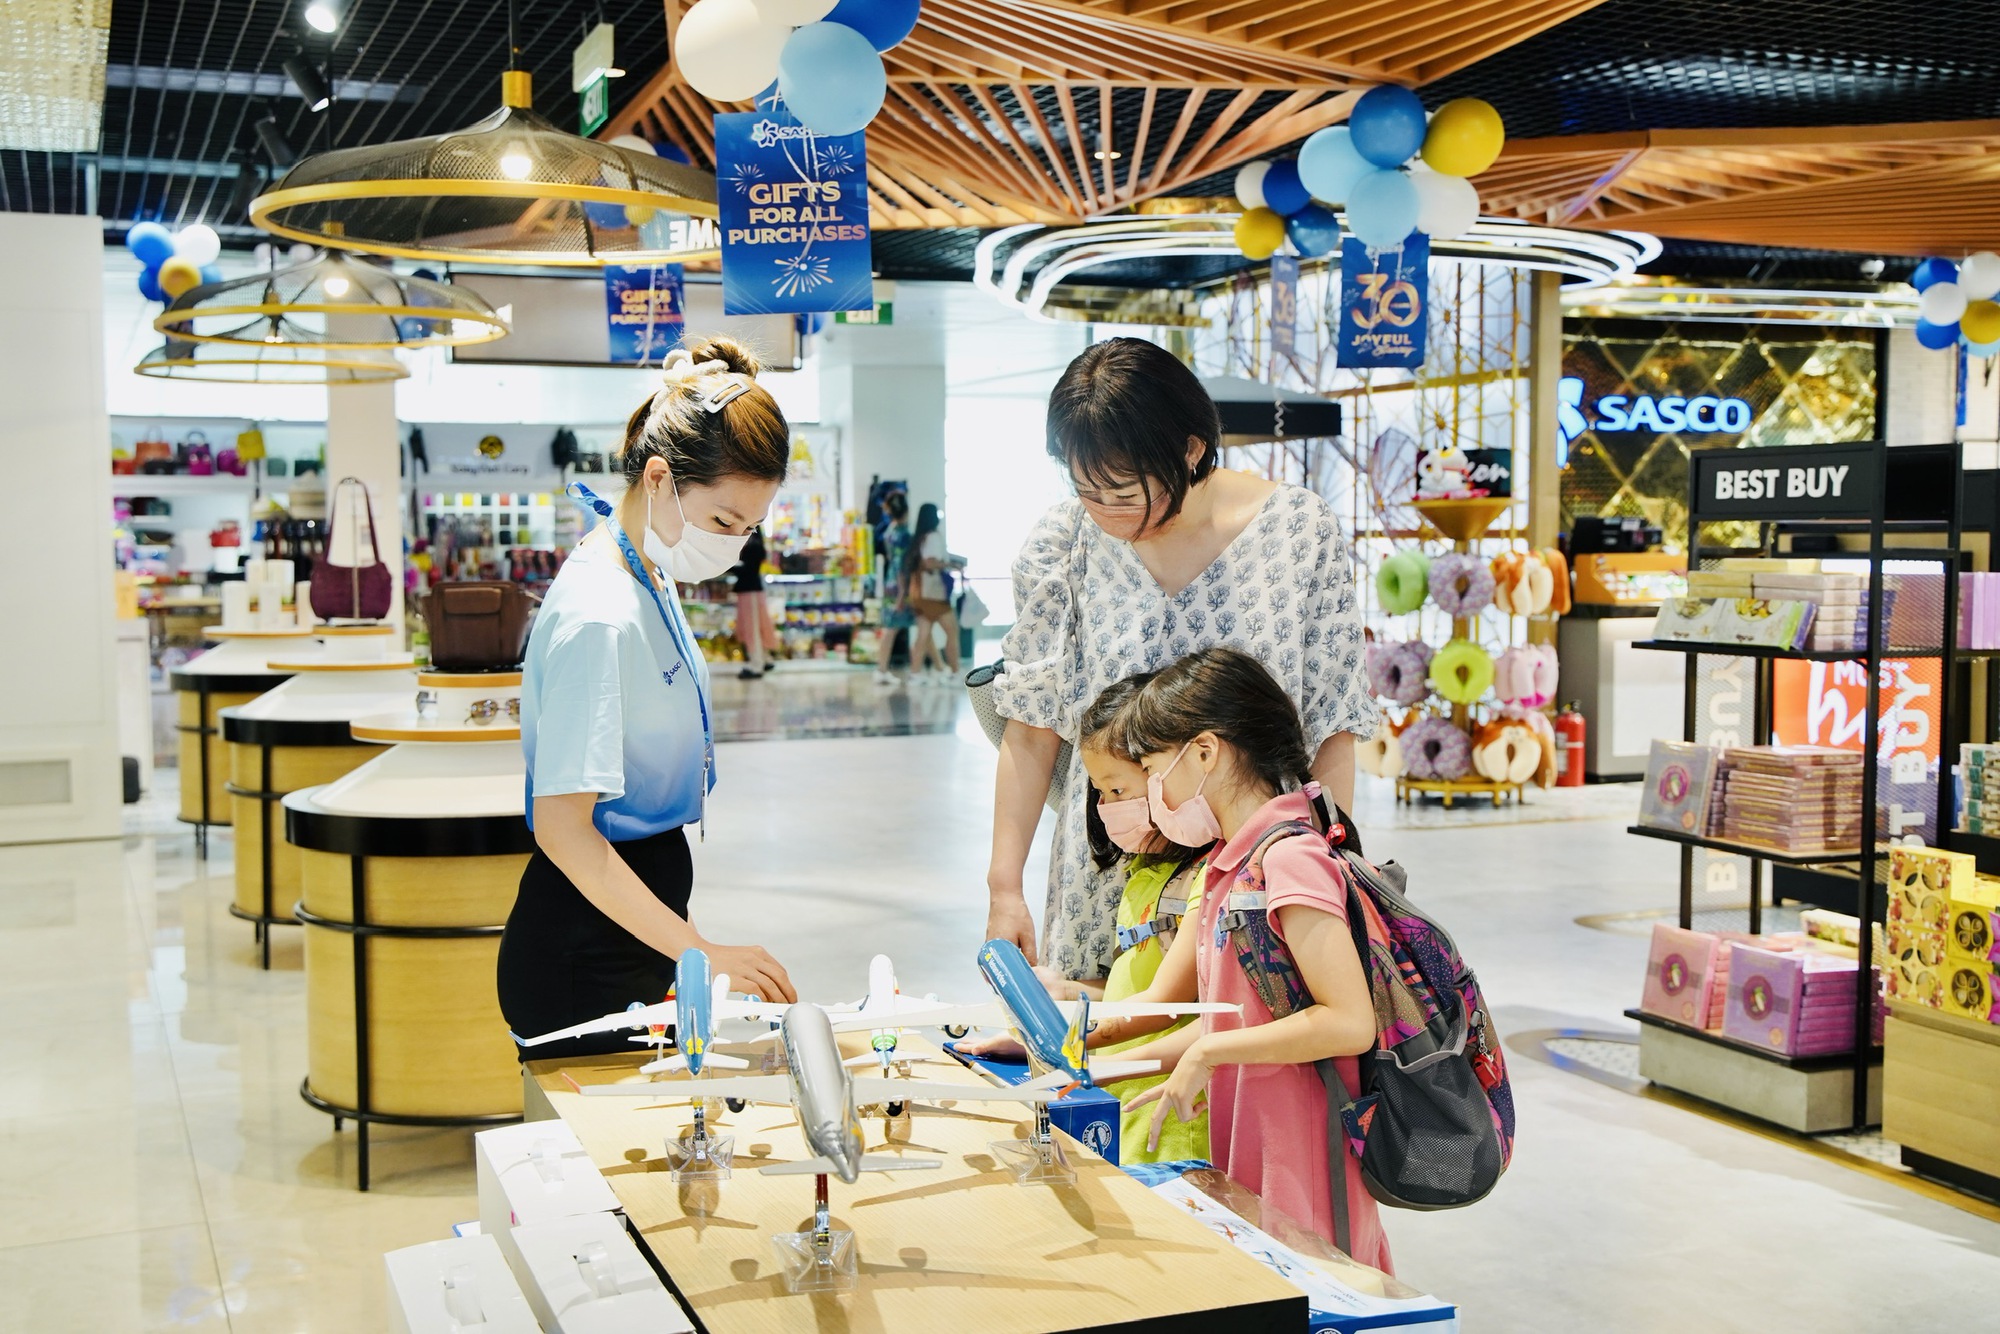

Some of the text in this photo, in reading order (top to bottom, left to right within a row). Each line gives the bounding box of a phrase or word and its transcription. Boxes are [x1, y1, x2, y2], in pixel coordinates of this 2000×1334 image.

[749, 181, 841, 205] GIFTS
[749, 206, 844, 224] FOR ALL
[728, 224, 867, 246] PURCHASES
[1351, 273, 1421, 330] 30
[1351, 333, 1413, 347] JOYFUL
[1596, 395, 1752, 434] SASCO
[1715, 464, 1849, 500] BEST BUY
